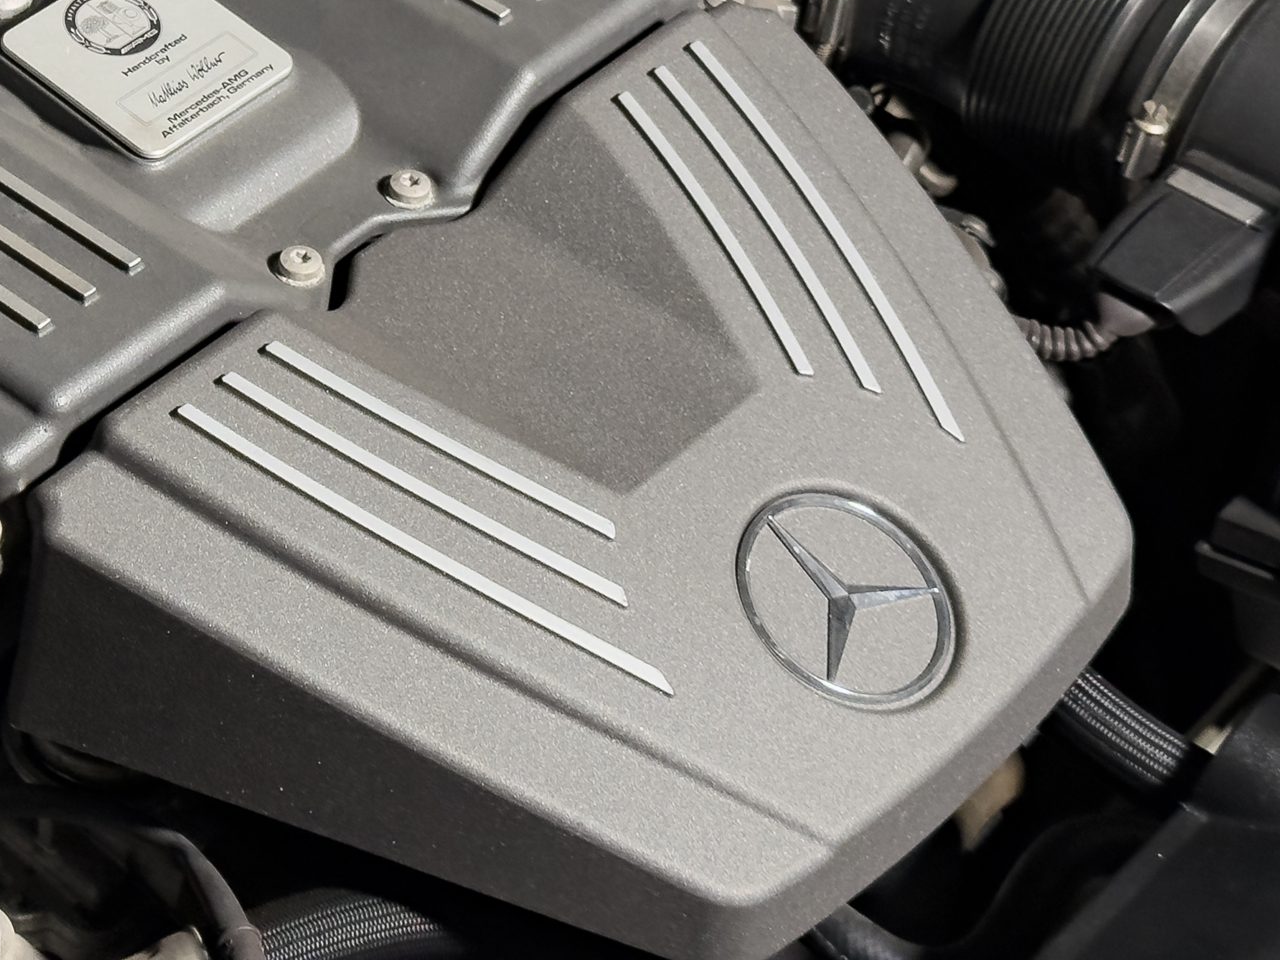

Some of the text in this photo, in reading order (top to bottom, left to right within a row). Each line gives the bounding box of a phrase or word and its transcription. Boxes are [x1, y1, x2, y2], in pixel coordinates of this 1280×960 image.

[121, 33, 188, 77] Handcrafted
[154, 54, 171, 66] by
[161, 63, 274, 139] Affalterbach, Germany
[167, 69, 249, 124] Mercedes-AMG
